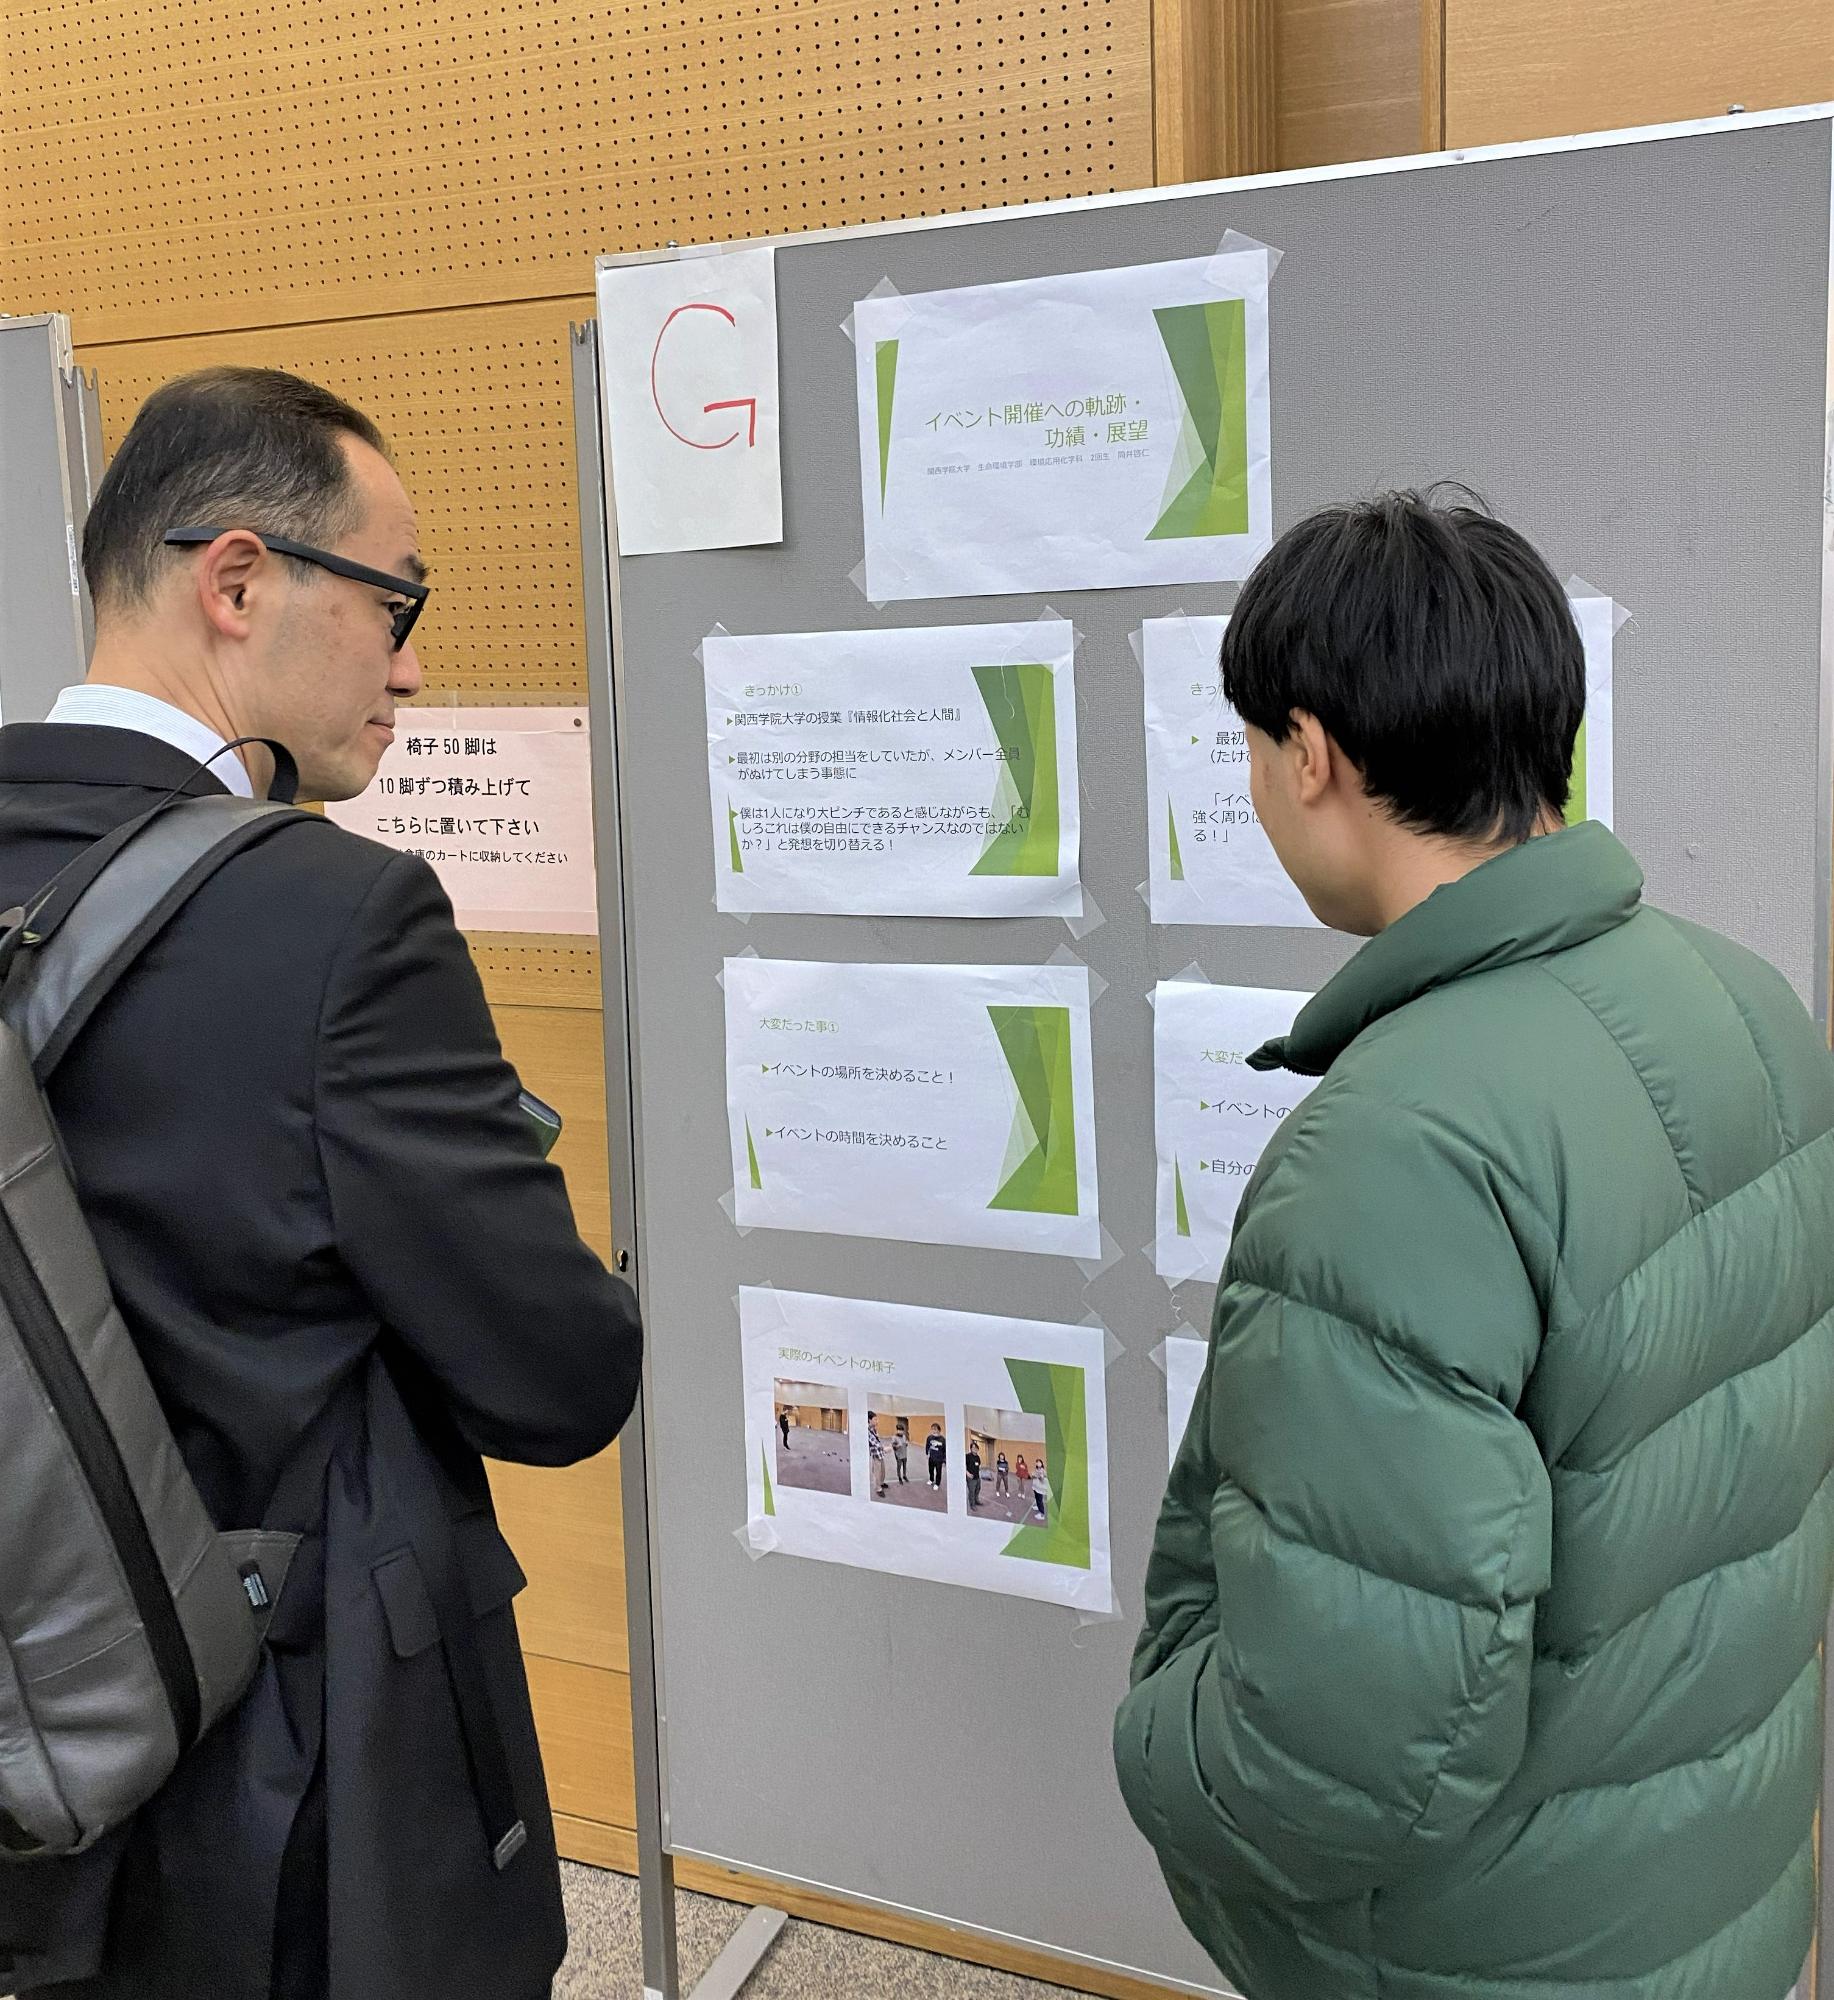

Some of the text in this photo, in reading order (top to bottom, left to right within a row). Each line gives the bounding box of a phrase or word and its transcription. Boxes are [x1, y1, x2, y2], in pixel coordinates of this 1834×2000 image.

[651, 303, 756, 449] G
[925, 393, 1141, 432] イベント開催への軌跡・
[1045, 419, 1149, 449] 功績・展望
[744, 682, 802, 697] きっかけ①
[734, 708, 961, 726] 関西学院大学の授業『情報化社会と人間』
[737, 747, 1020, 764] 最初は別の分野の担当をしていたが、メンバー全員
[738, 766, 857, 780] がぬけてしまう事態に
[377, 817, 539, 835] こちらに置いて下さい
[742, 821, 1024, 836] しろこれは僕の自由にできるチャンスなのではない
[742, 838, 893, 851] か？」と発想を切り替える！
[1193, 829, 1228, 842] る！」
[759, 1017, 840, 1034] 大変だった事①
[770, 1062, 953, 1084] イベントの場所を決めること！
[774, 1126, 948, 1150] イベントの時間を決めること
[778, 1347, 896, 1374] 実際のイベントの様子
